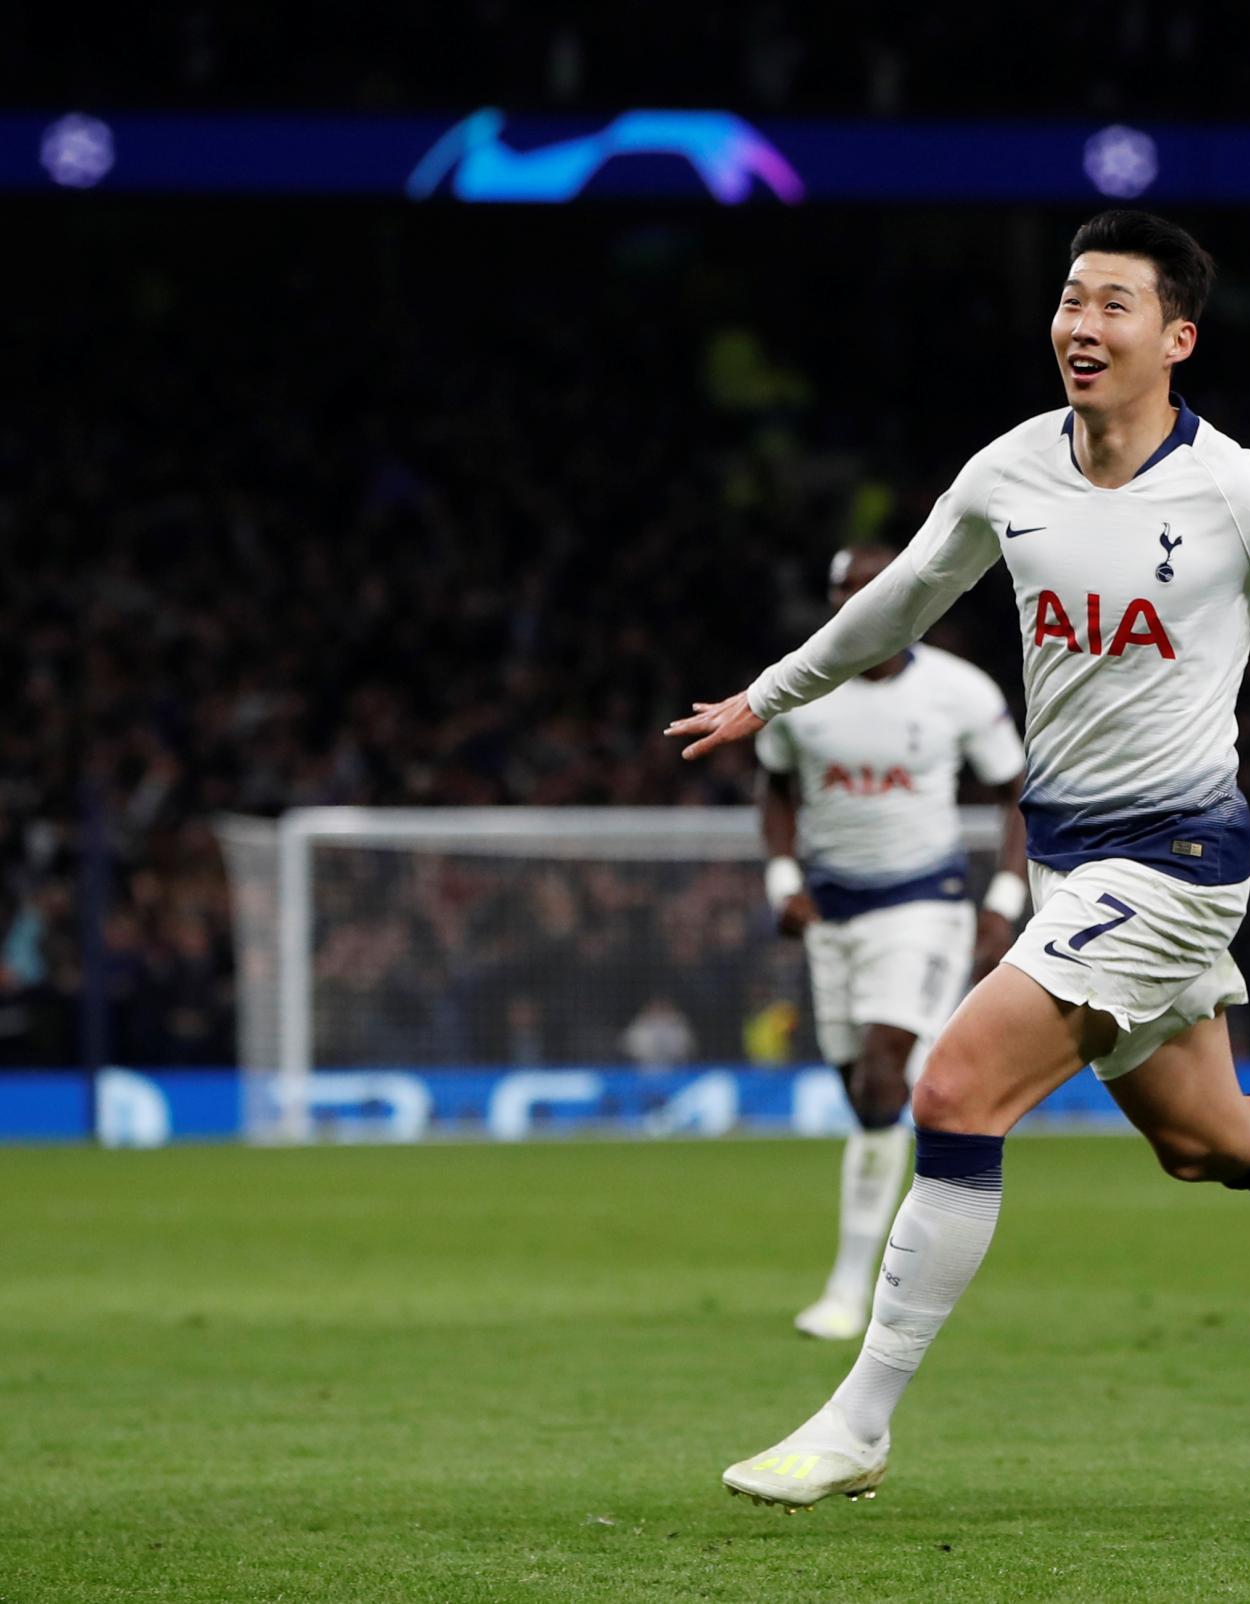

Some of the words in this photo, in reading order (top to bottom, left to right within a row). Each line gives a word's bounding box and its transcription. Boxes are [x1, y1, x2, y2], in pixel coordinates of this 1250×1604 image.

[1034, 589, 1177, 661] AIA
[822, 760, 914, 795] AIA
[1067, 892, 1138, 952] 7
